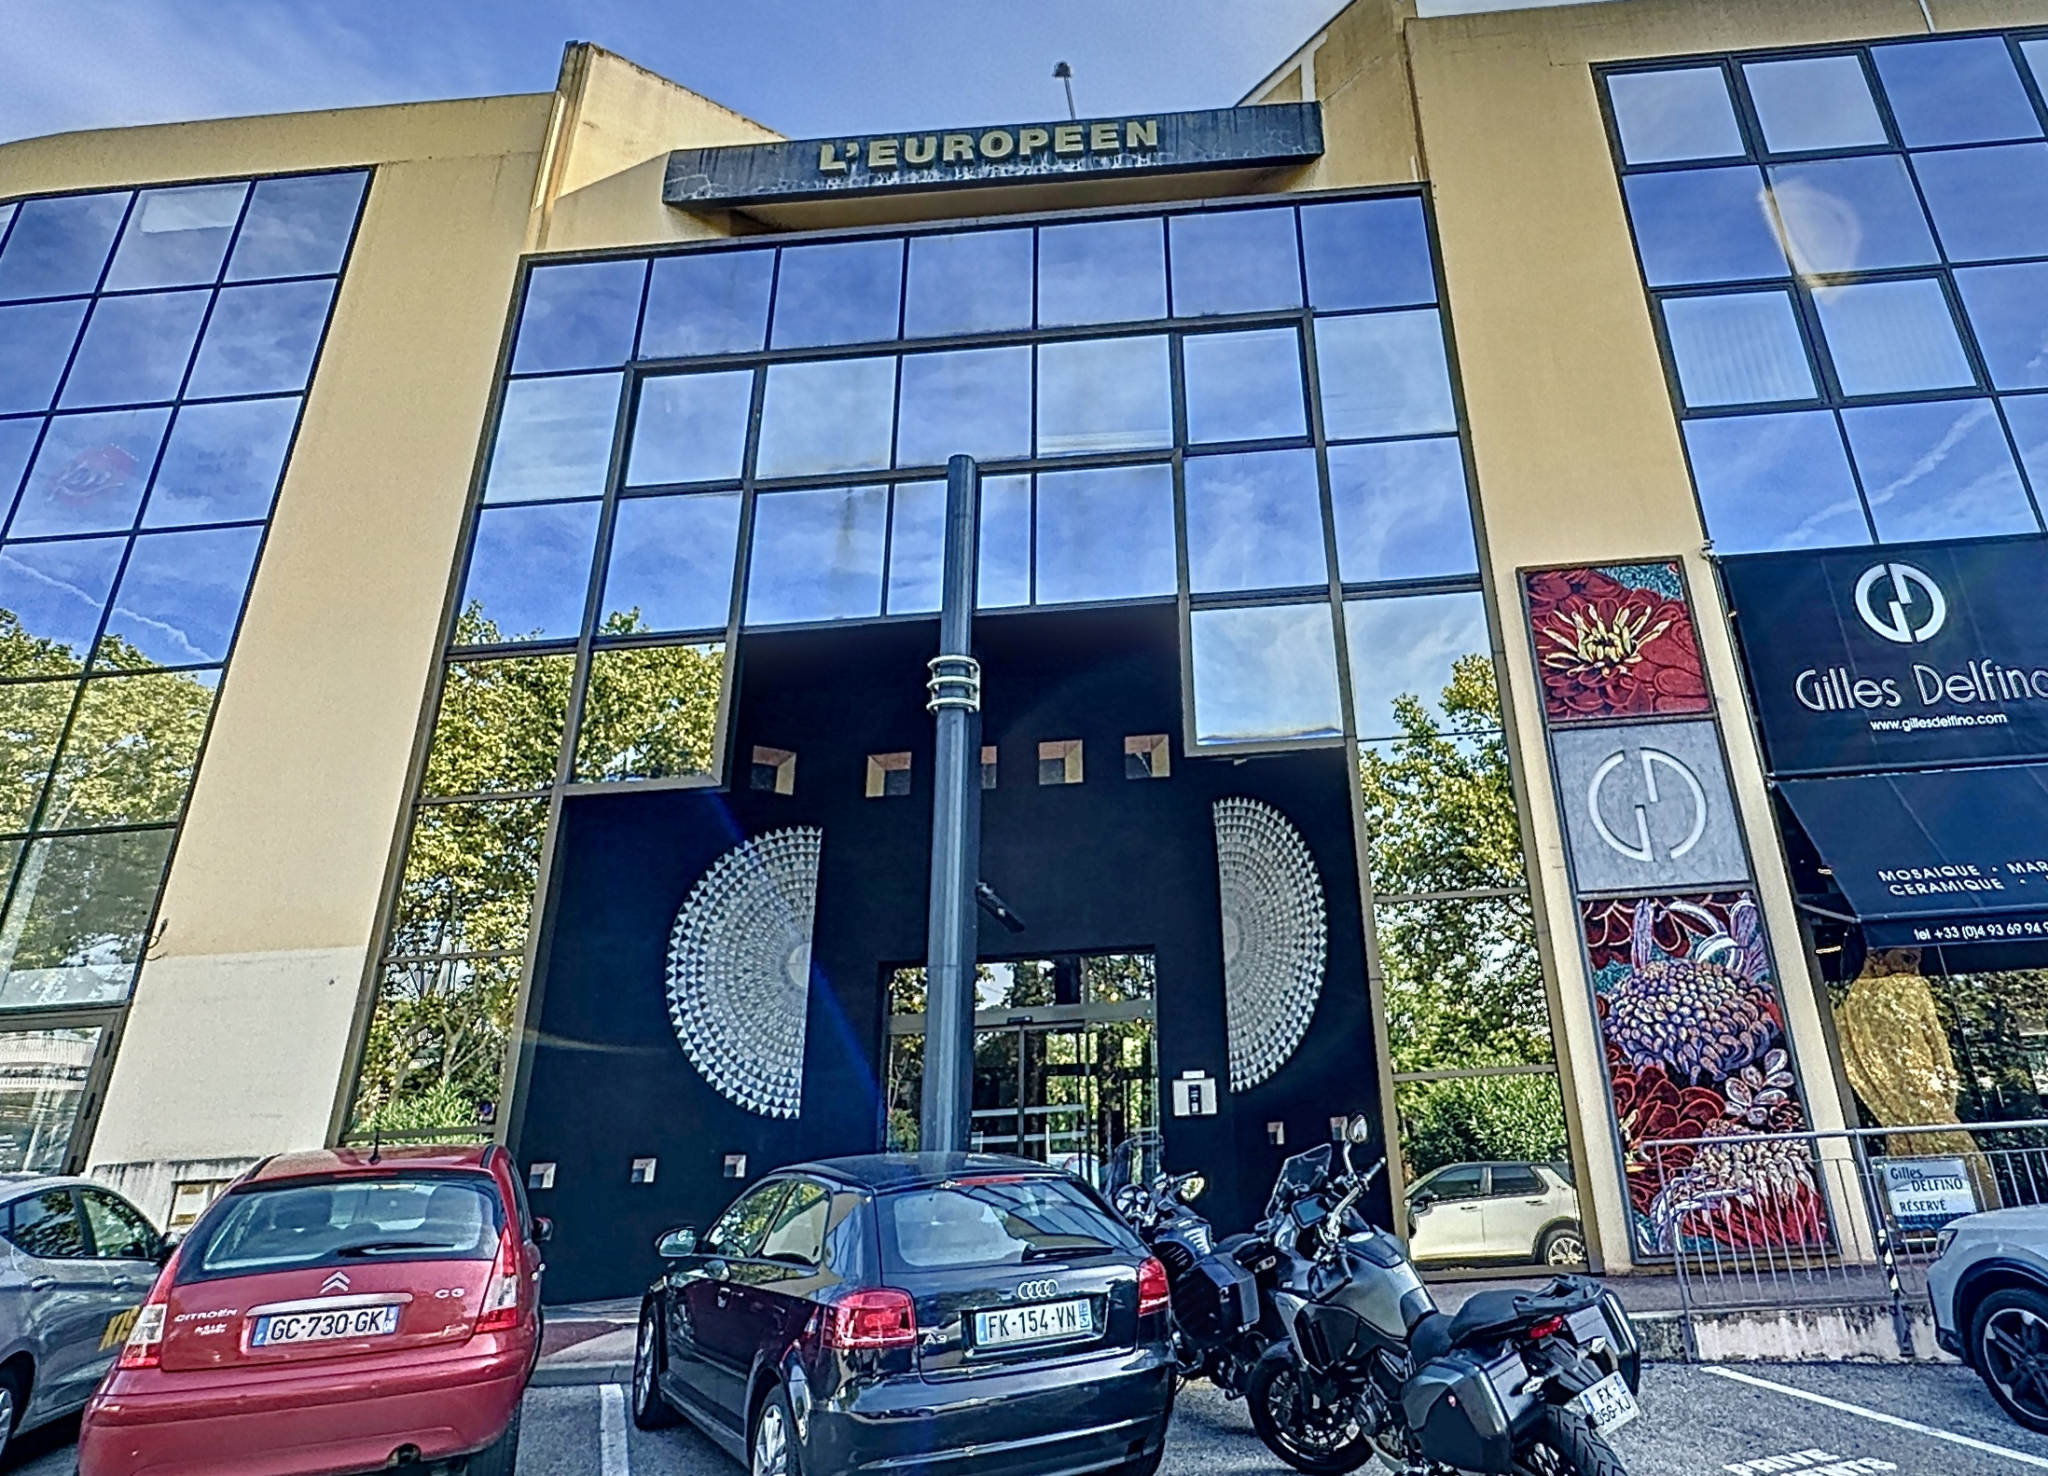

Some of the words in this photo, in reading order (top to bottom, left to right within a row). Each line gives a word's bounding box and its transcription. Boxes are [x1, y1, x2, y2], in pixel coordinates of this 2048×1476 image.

[818, 119, 1160, 175] L'EUROPEEN
[1796, 668, 1902, 711] Gilles
[1870, 713, 2009, 732] www.gillesdelfino.com
[1878, 865, 1981, 882] MOSAIQUE
[1889, 878, 2006, 896] CERAMIQUE
[1914, 928, 1931, 940] tel
[1934, 925, 1960, 939] +33
[1962, 923, 1986, 940] (0)4
[1987, 923, 2005, 936] 93
[2006, 922, 2022, 936] 69
[2024, 922, 2042, 935] 94
[1890, 1167, 1923, 1180] Gilles
[1911, 1178, 1963, 1192] DELFINO
